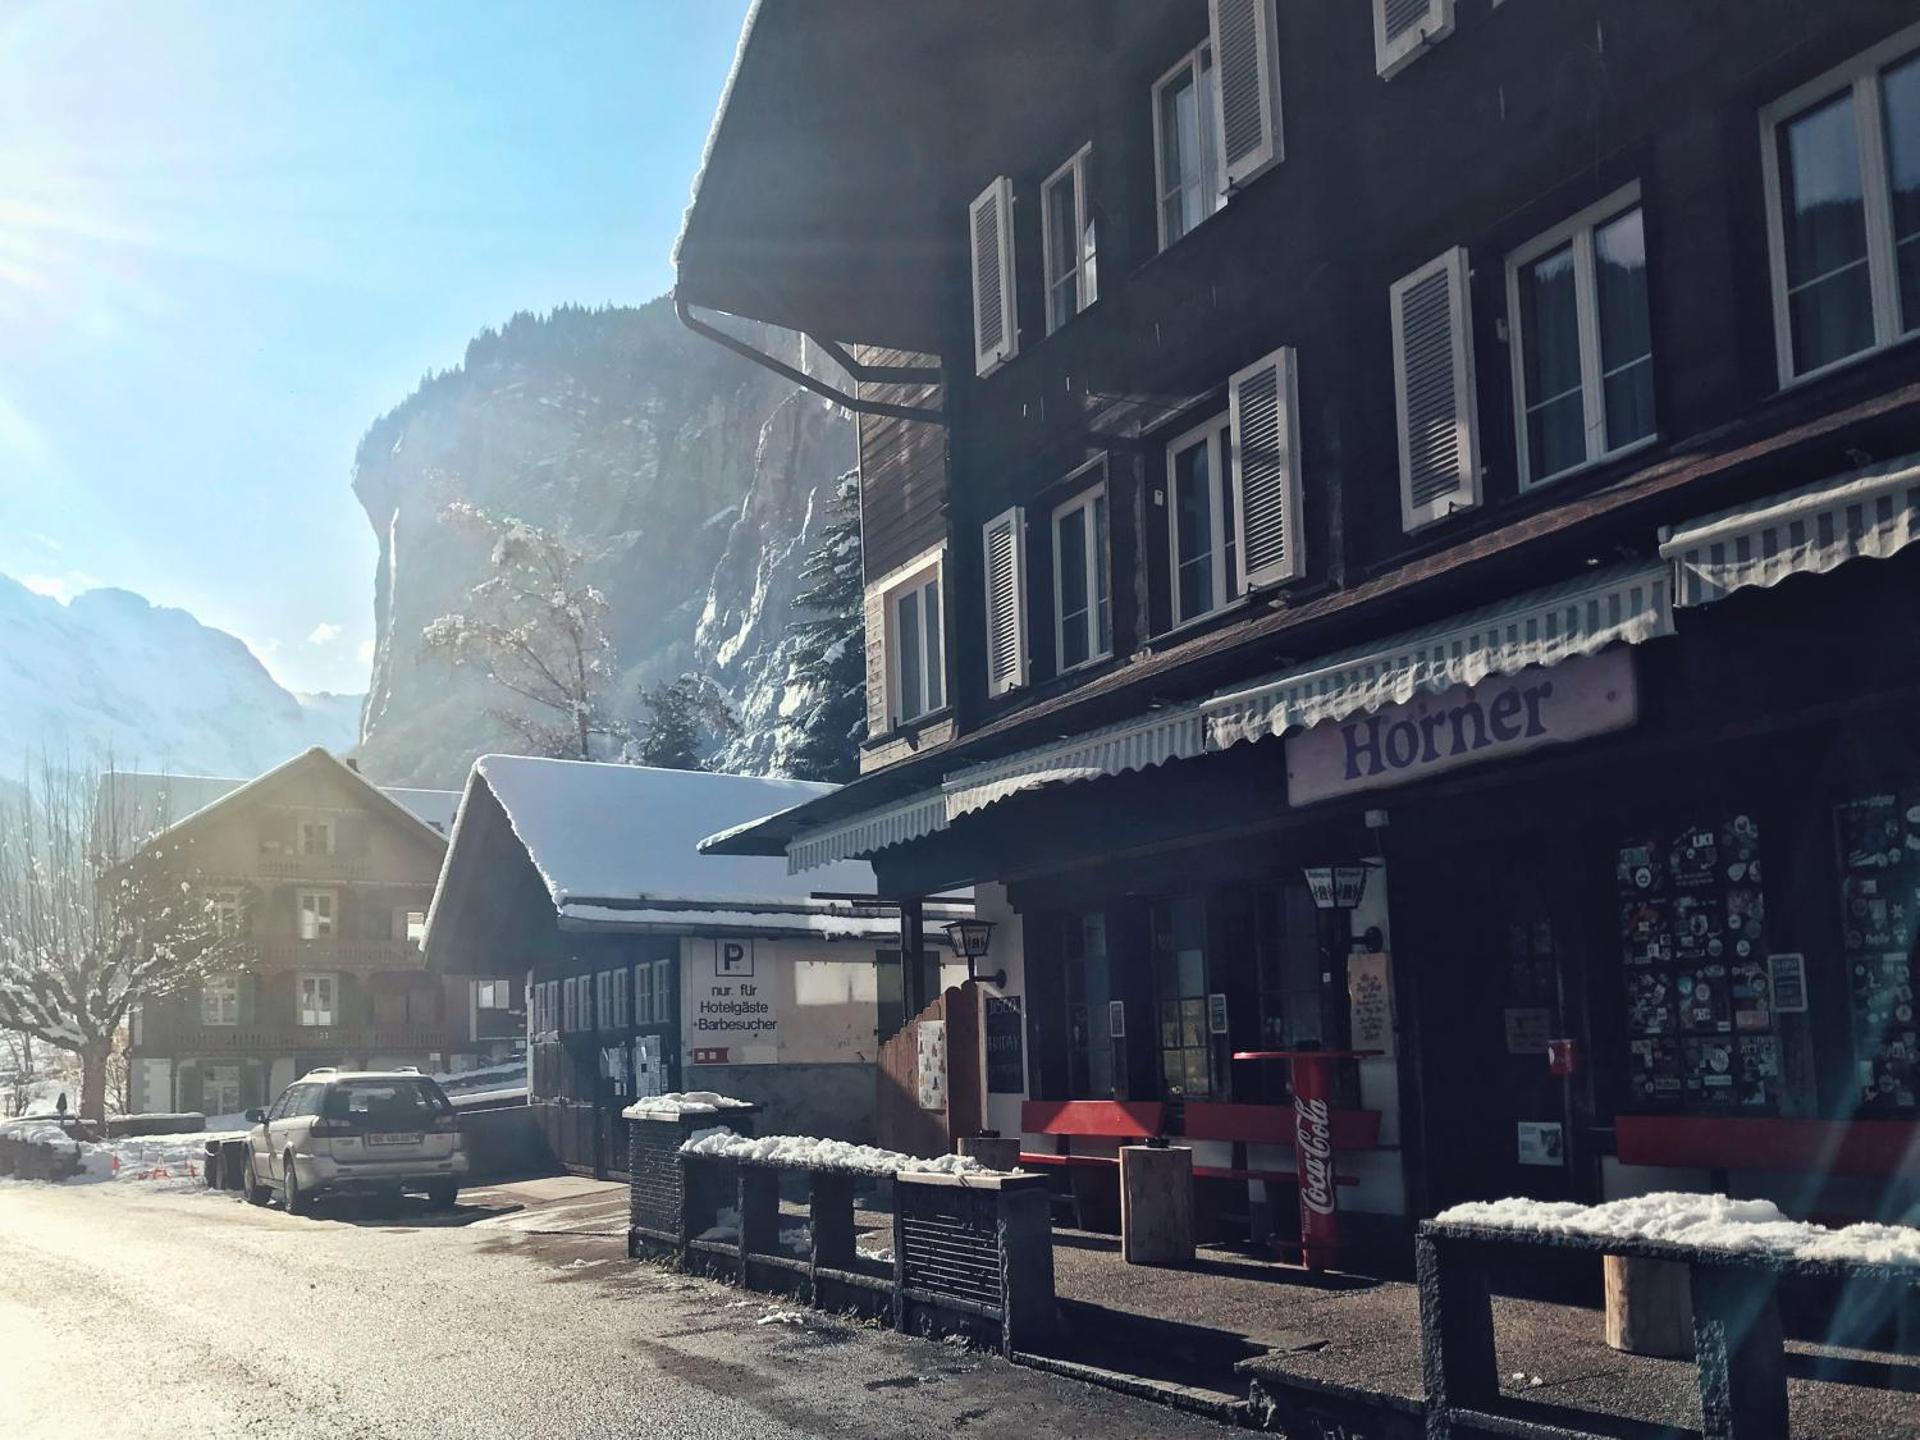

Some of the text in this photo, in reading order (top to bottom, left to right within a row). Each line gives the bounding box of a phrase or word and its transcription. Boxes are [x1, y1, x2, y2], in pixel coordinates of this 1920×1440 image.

[1343, 680, 1552, 780] Horner
[724, 943, 744, 970] P
[711, 984, 758, 997] nur für
[699, 1001, 769, 1016] Hotelgäste
